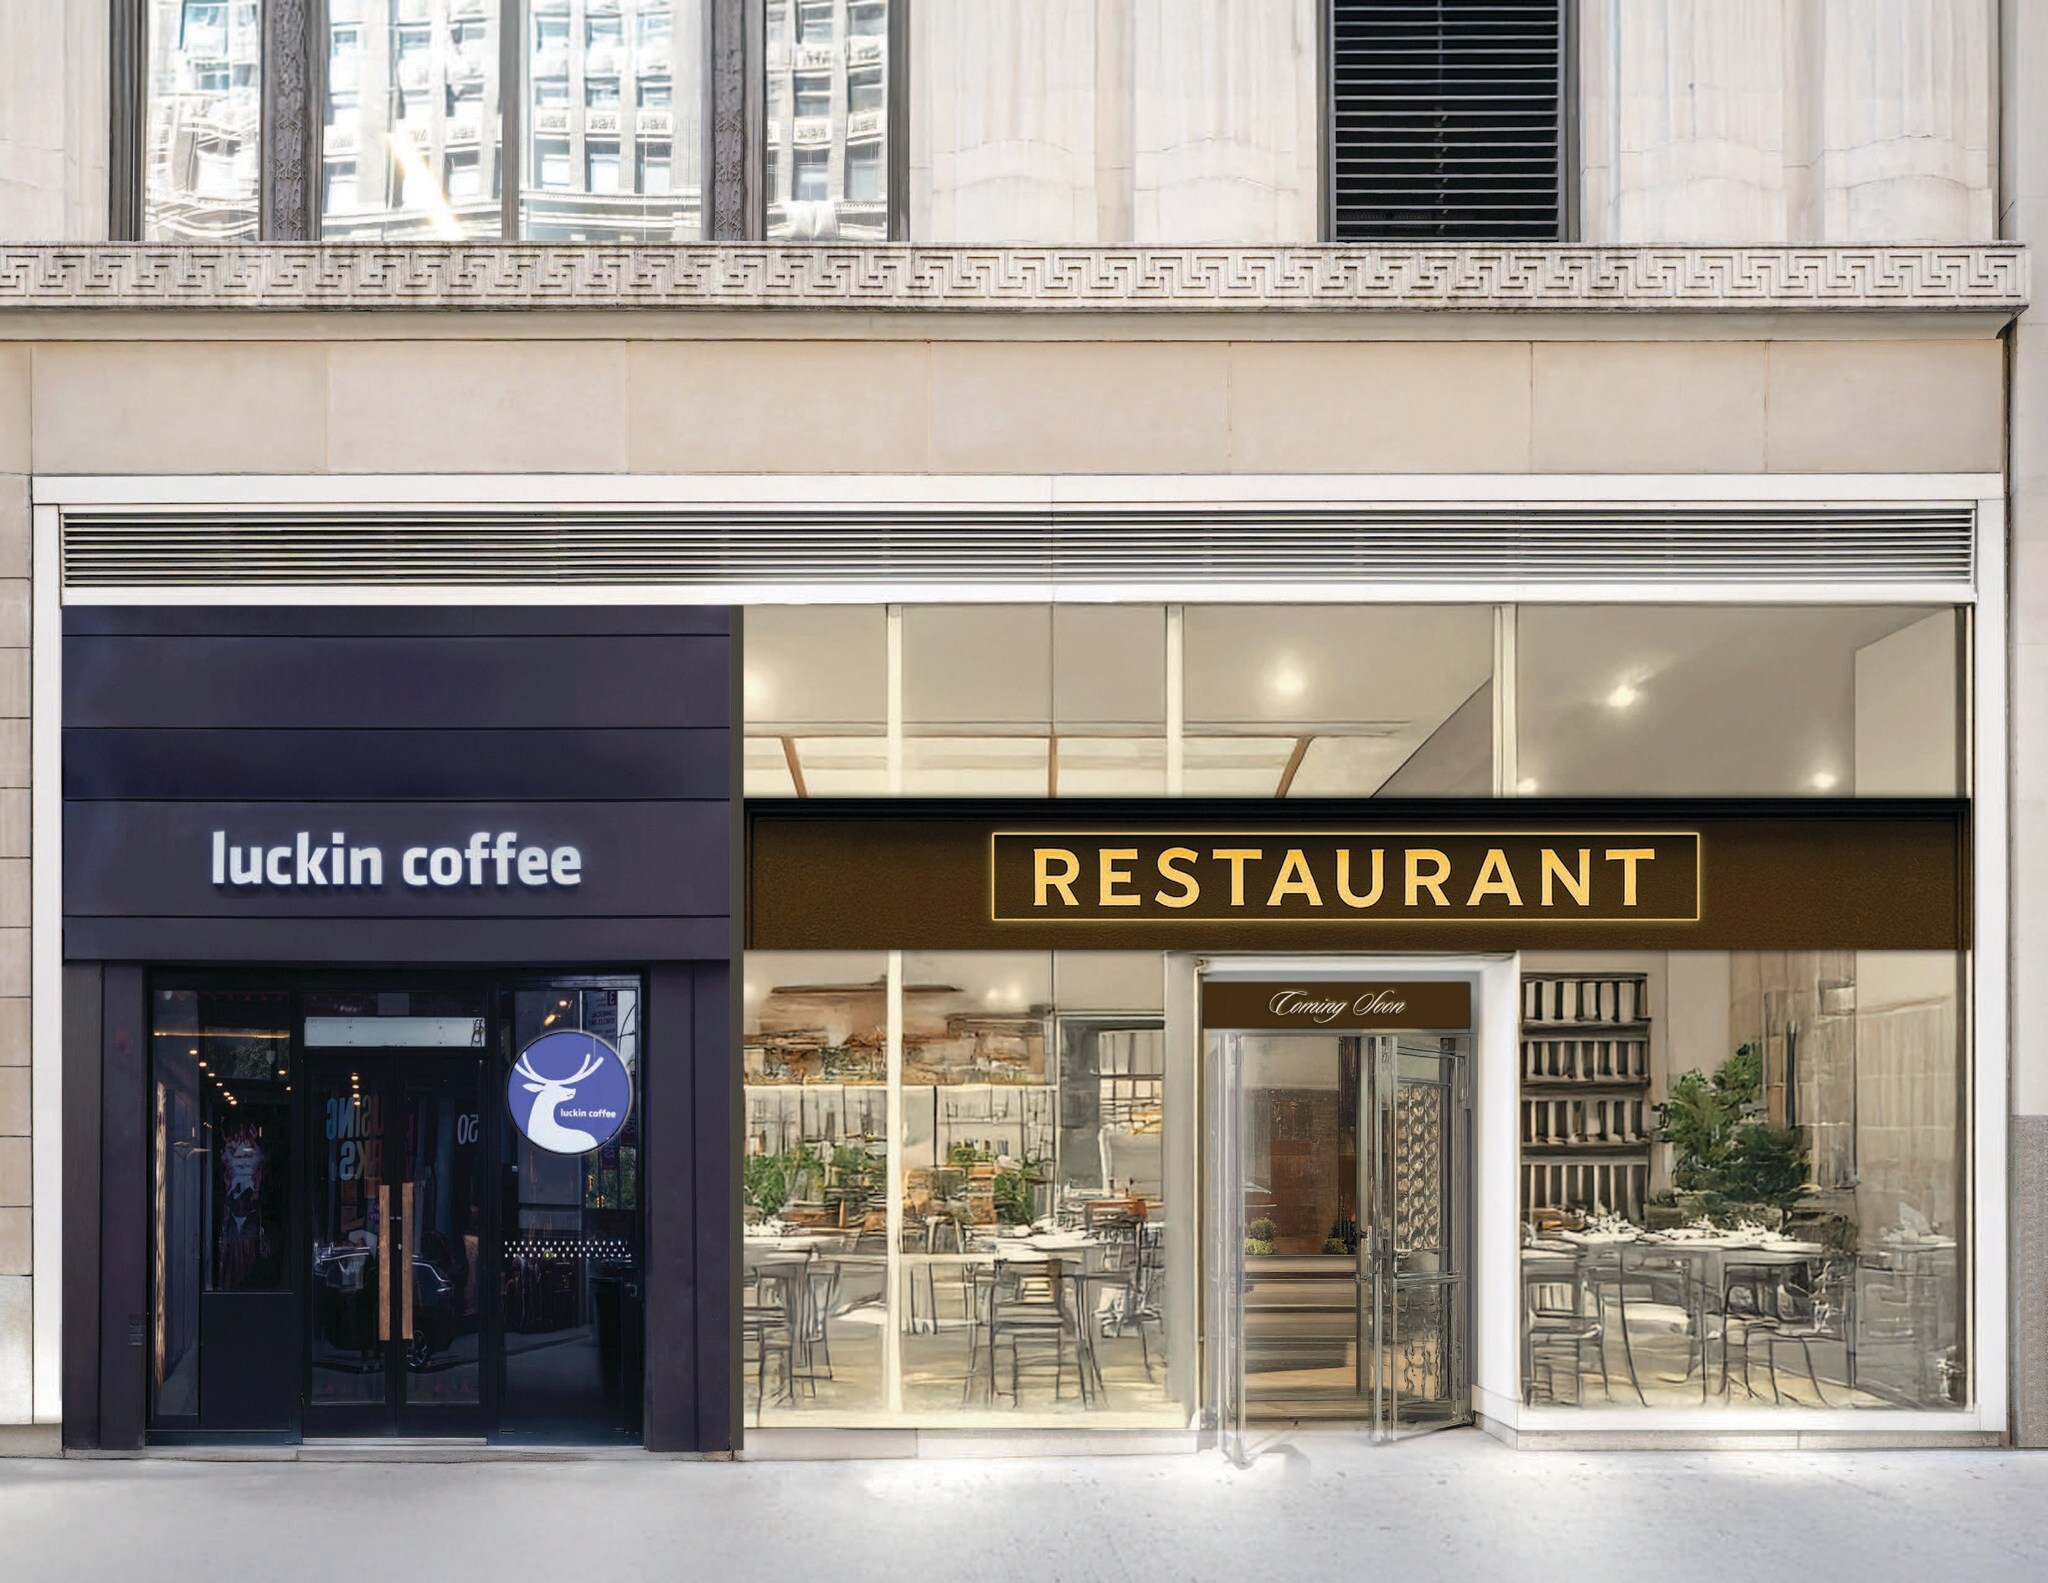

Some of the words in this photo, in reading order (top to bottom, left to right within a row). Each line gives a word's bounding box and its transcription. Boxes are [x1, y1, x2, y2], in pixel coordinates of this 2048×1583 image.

[212, 830, 383, 886] luckin
[402, 831, 582, 887] coffee
[1032, 847, 1657, 908] RESTAURANT
[1268, 990, 1348, 1024] Coming
[1352, 990, 1406, 1016] Soon
[560, 1108, 587, 1118] luckin
[588, 1108, 616, 1119] coffee
